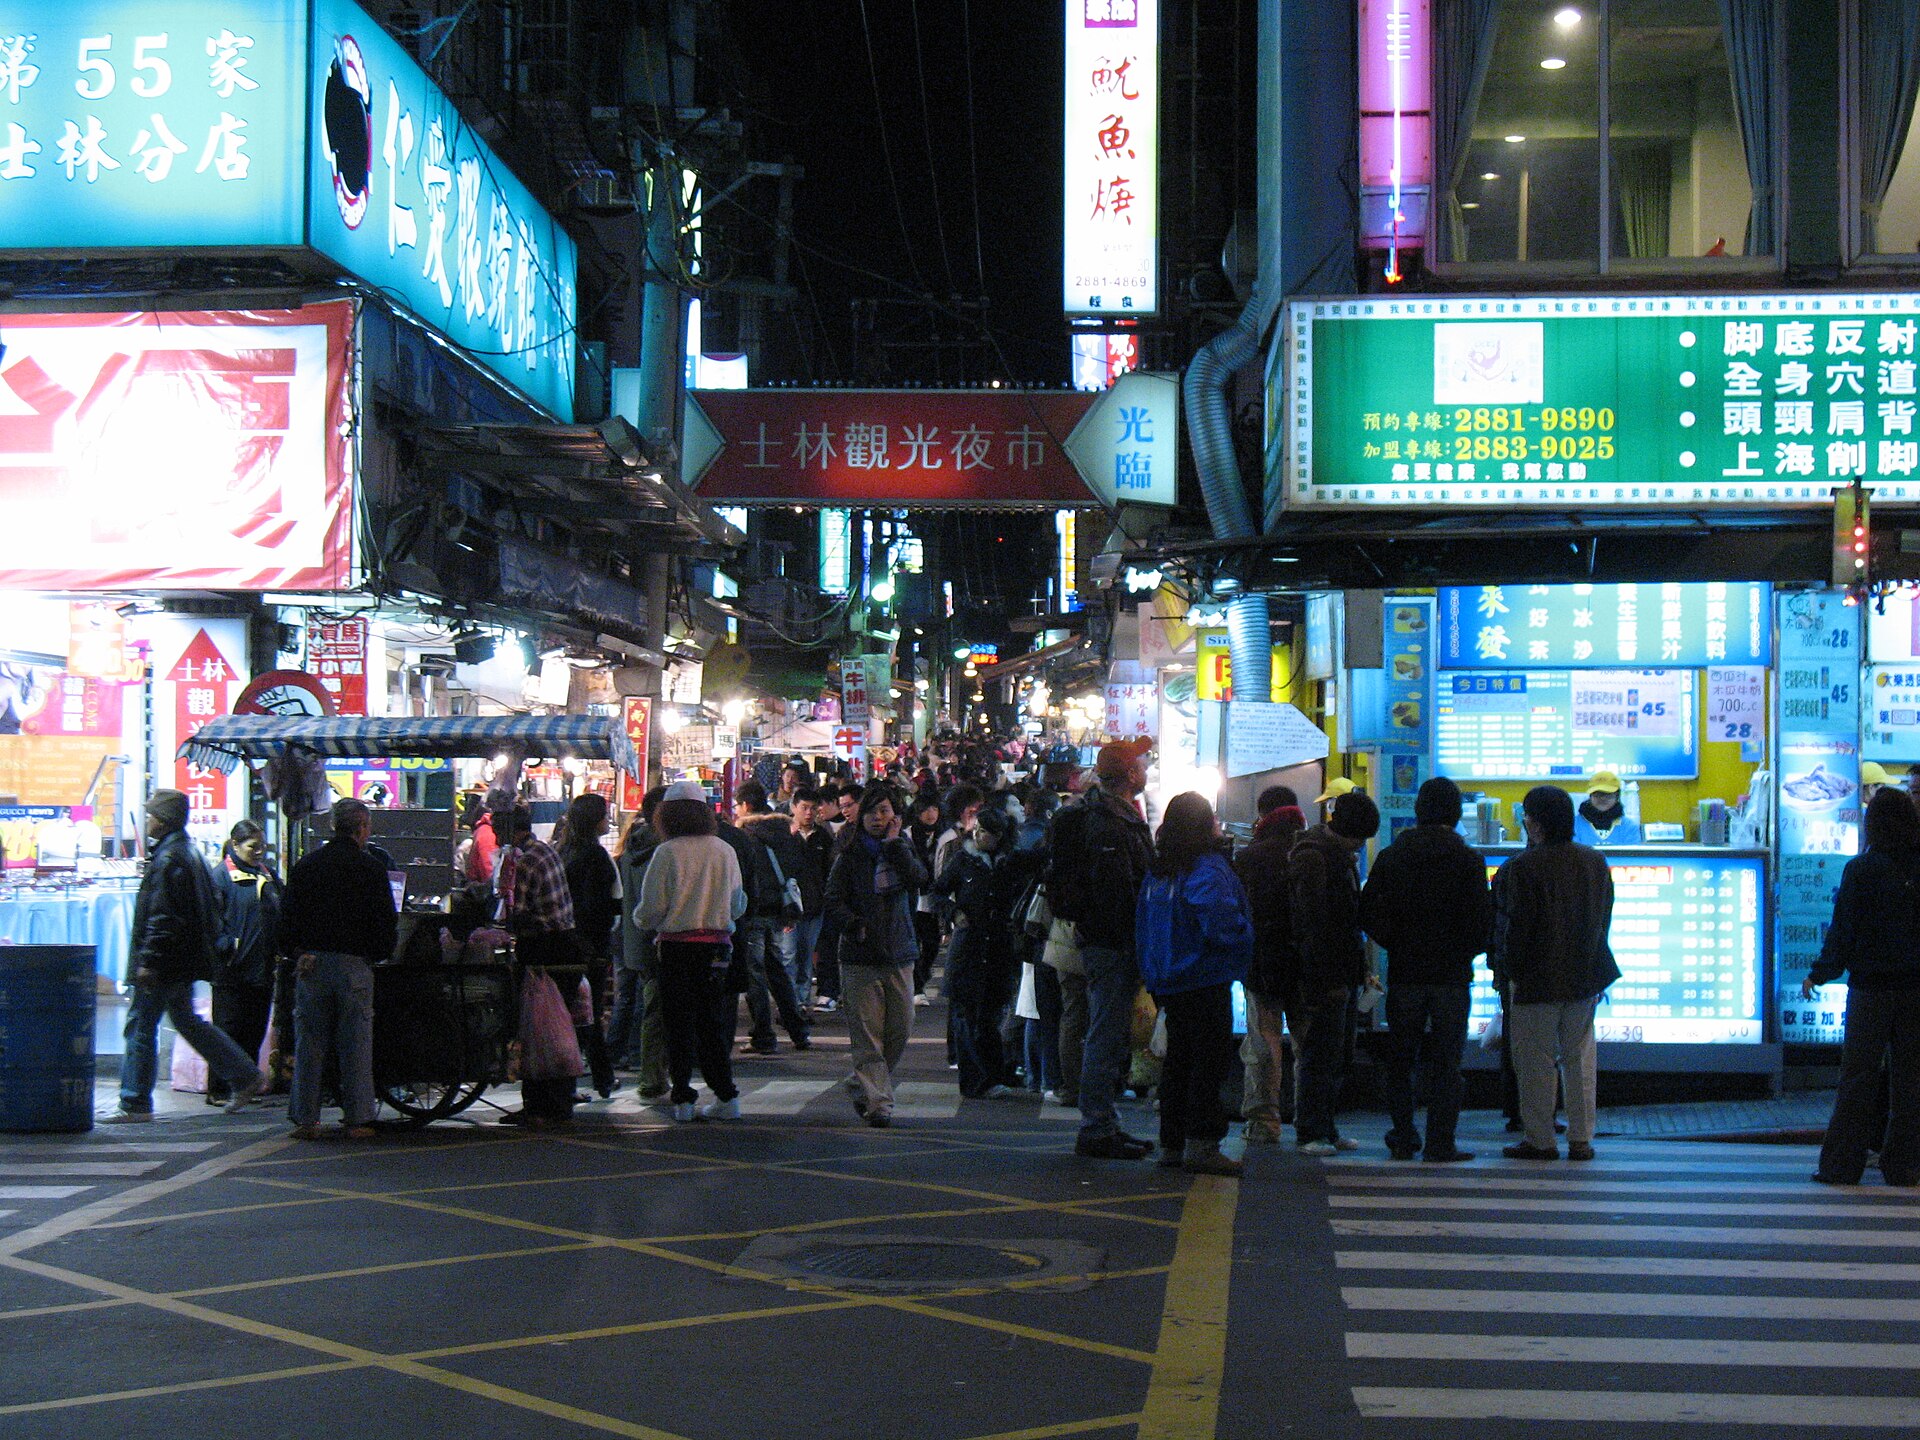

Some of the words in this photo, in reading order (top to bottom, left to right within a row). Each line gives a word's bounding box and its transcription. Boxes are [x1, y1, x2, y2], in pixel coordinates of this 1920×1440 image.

[0, 112, 250, 183] 士林分店
[1075, 276, 1147, 288] 2881-4869
[1723, 360, 1918, 396] 全身穴道
[1454, 408, 1615, 432] 2881-9890
[1722, 400, 1918, 436] 頭頸肩背
[738, 422, 1049, 471] 士林觀光夜市
[1115, 406, 1154, 490] 光臨
[1454, 436, 1615, 460] 2883-9025
[1831, 629, 1849, 648] 28
[177, 658, 227, 683] 士林
[1457, 678, 1522, 692] 今日特價
[1831, 684, 1849, 703] 45
[1642, 702, 1666, 716] 45
[1725, 722, 1752, 738] 28
[1720, 868, 1733, 881] 大
